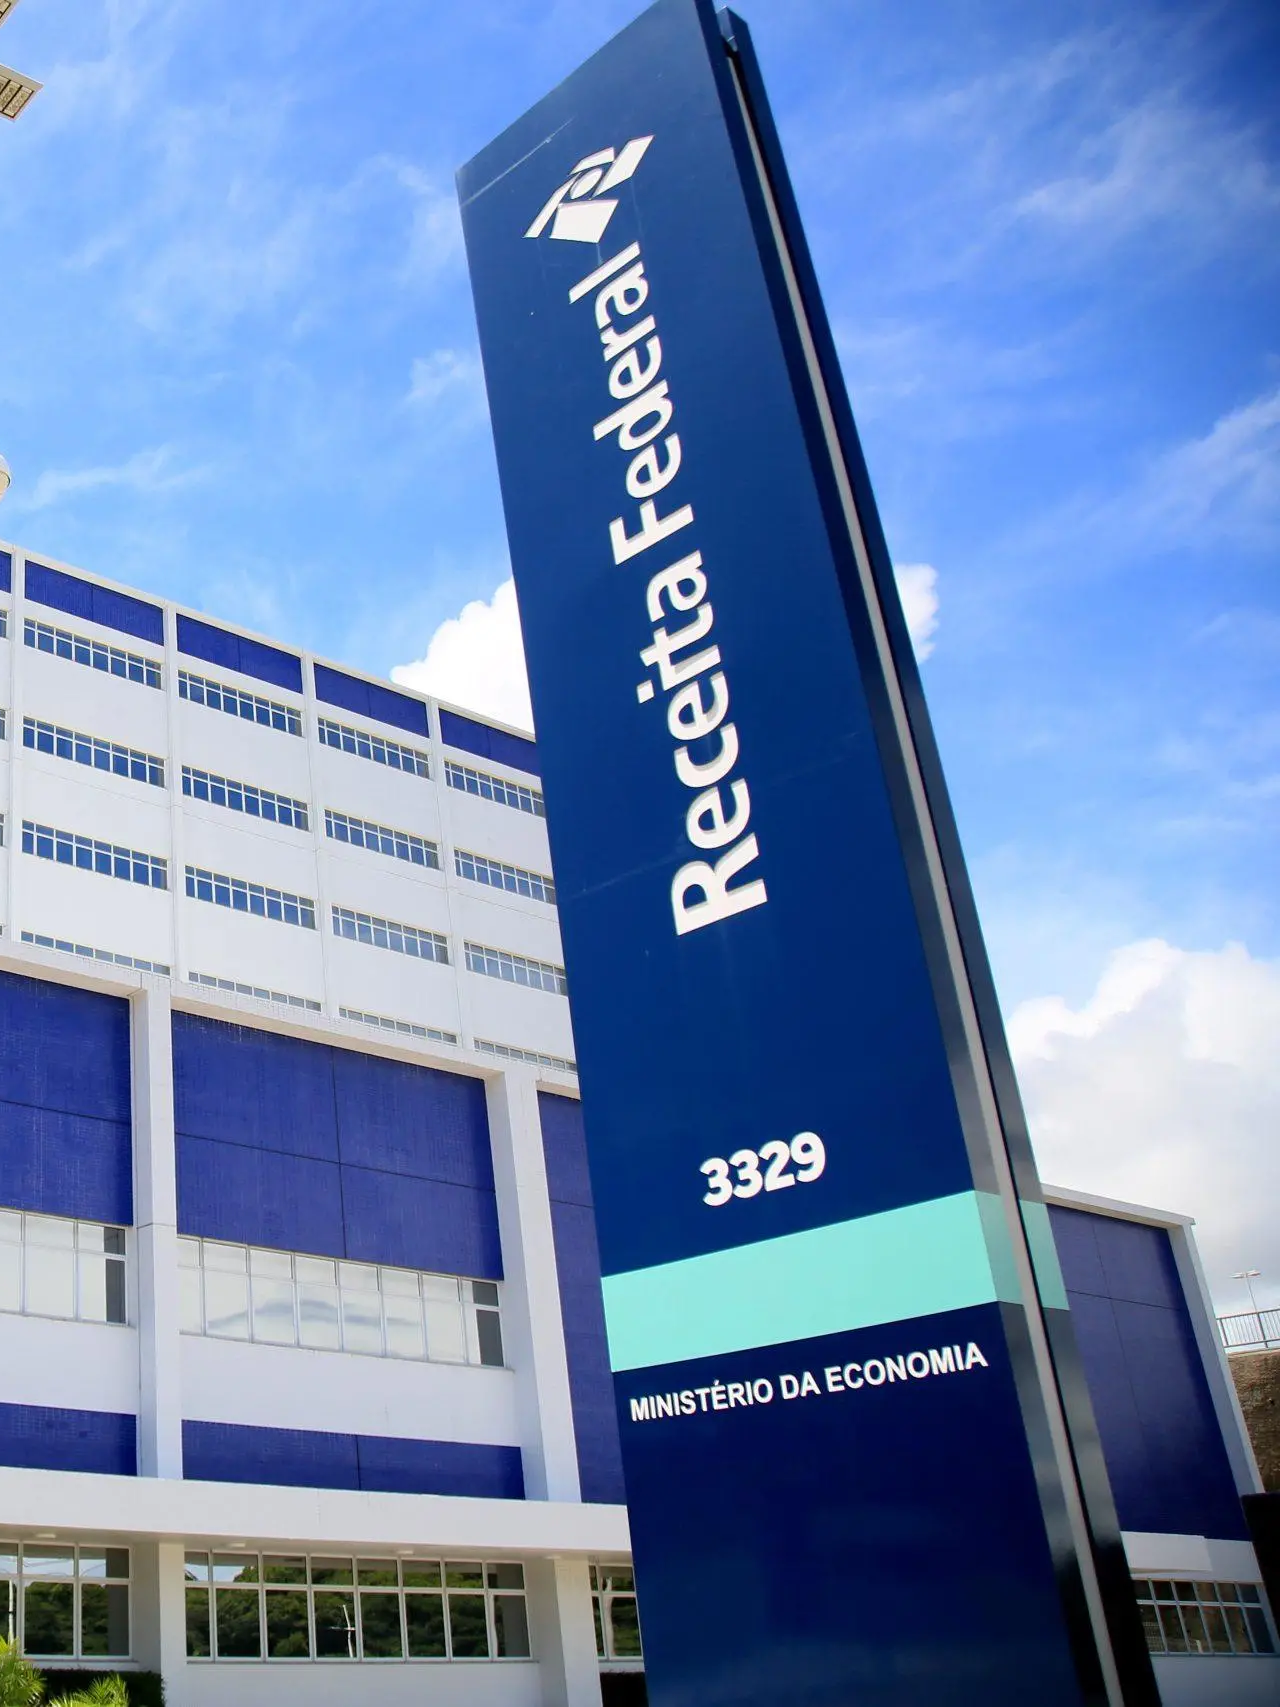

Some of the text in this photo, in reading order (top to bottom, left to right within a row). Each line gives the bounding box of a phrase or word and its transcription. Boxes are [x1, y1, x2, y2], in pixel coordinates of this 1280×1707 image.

[570, 241, 768, 936] Receita Federal
[700, 1131, 826, 1207] 3329
[630, 1342, 989, 1422] MINISTÉRIO DA ECONOMIA
